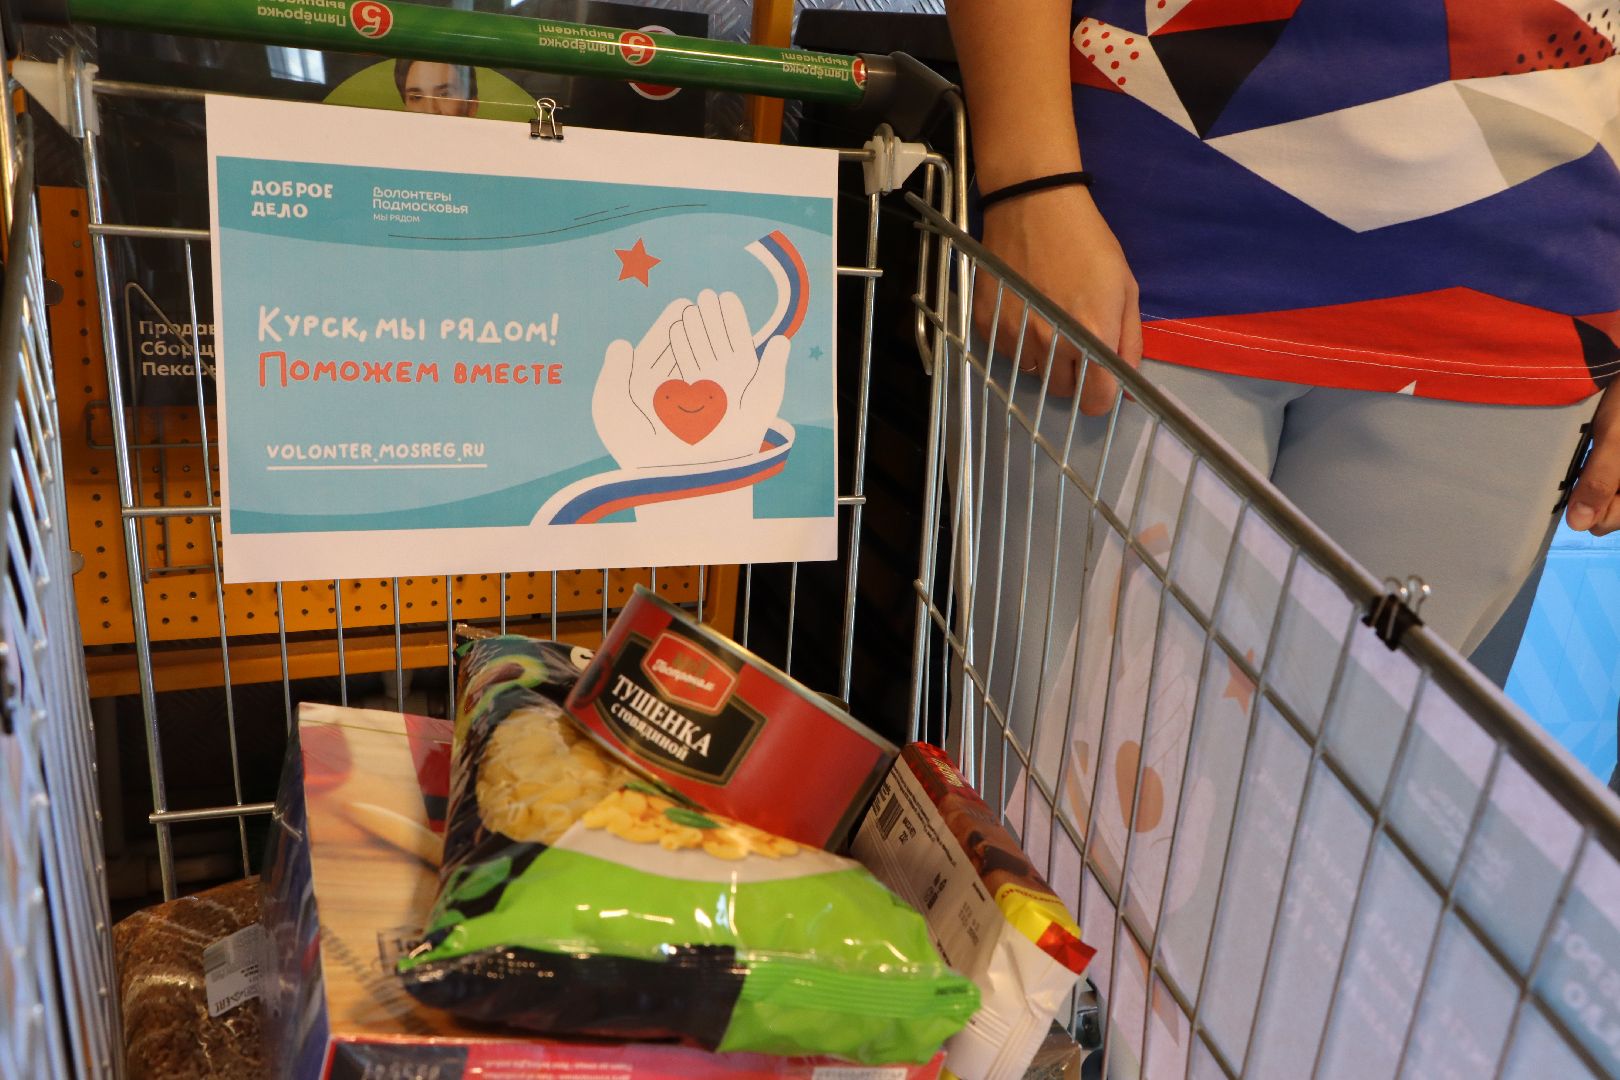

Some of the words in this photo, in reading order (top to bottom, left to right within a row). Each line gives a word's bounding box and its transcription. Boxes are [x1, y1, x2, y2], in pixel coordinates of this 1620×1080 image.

[257, 6, 346, 27] Пятёрочка
[539, 36, 616, 56] Пятёрочка
[782, 62, 849, 81] Пятёрочка
[251, 180, 333, 199] ДОБРОЕ
[251, 201, 309, 219] ДЕЛО
[373, 213, 388, 222] МЫ
[389, 214, 420, 223] РЯДОМ
[375, 317, 425, 341] МЫ
[453, 361, 563, 385] ВМЕСТЕ
[266, 442, 485, 463] VOLONTER.MOSREG.RU
[611, 674, 712, 758] ТУШЕНКА
[617, 706, 691, 762] говядиной
